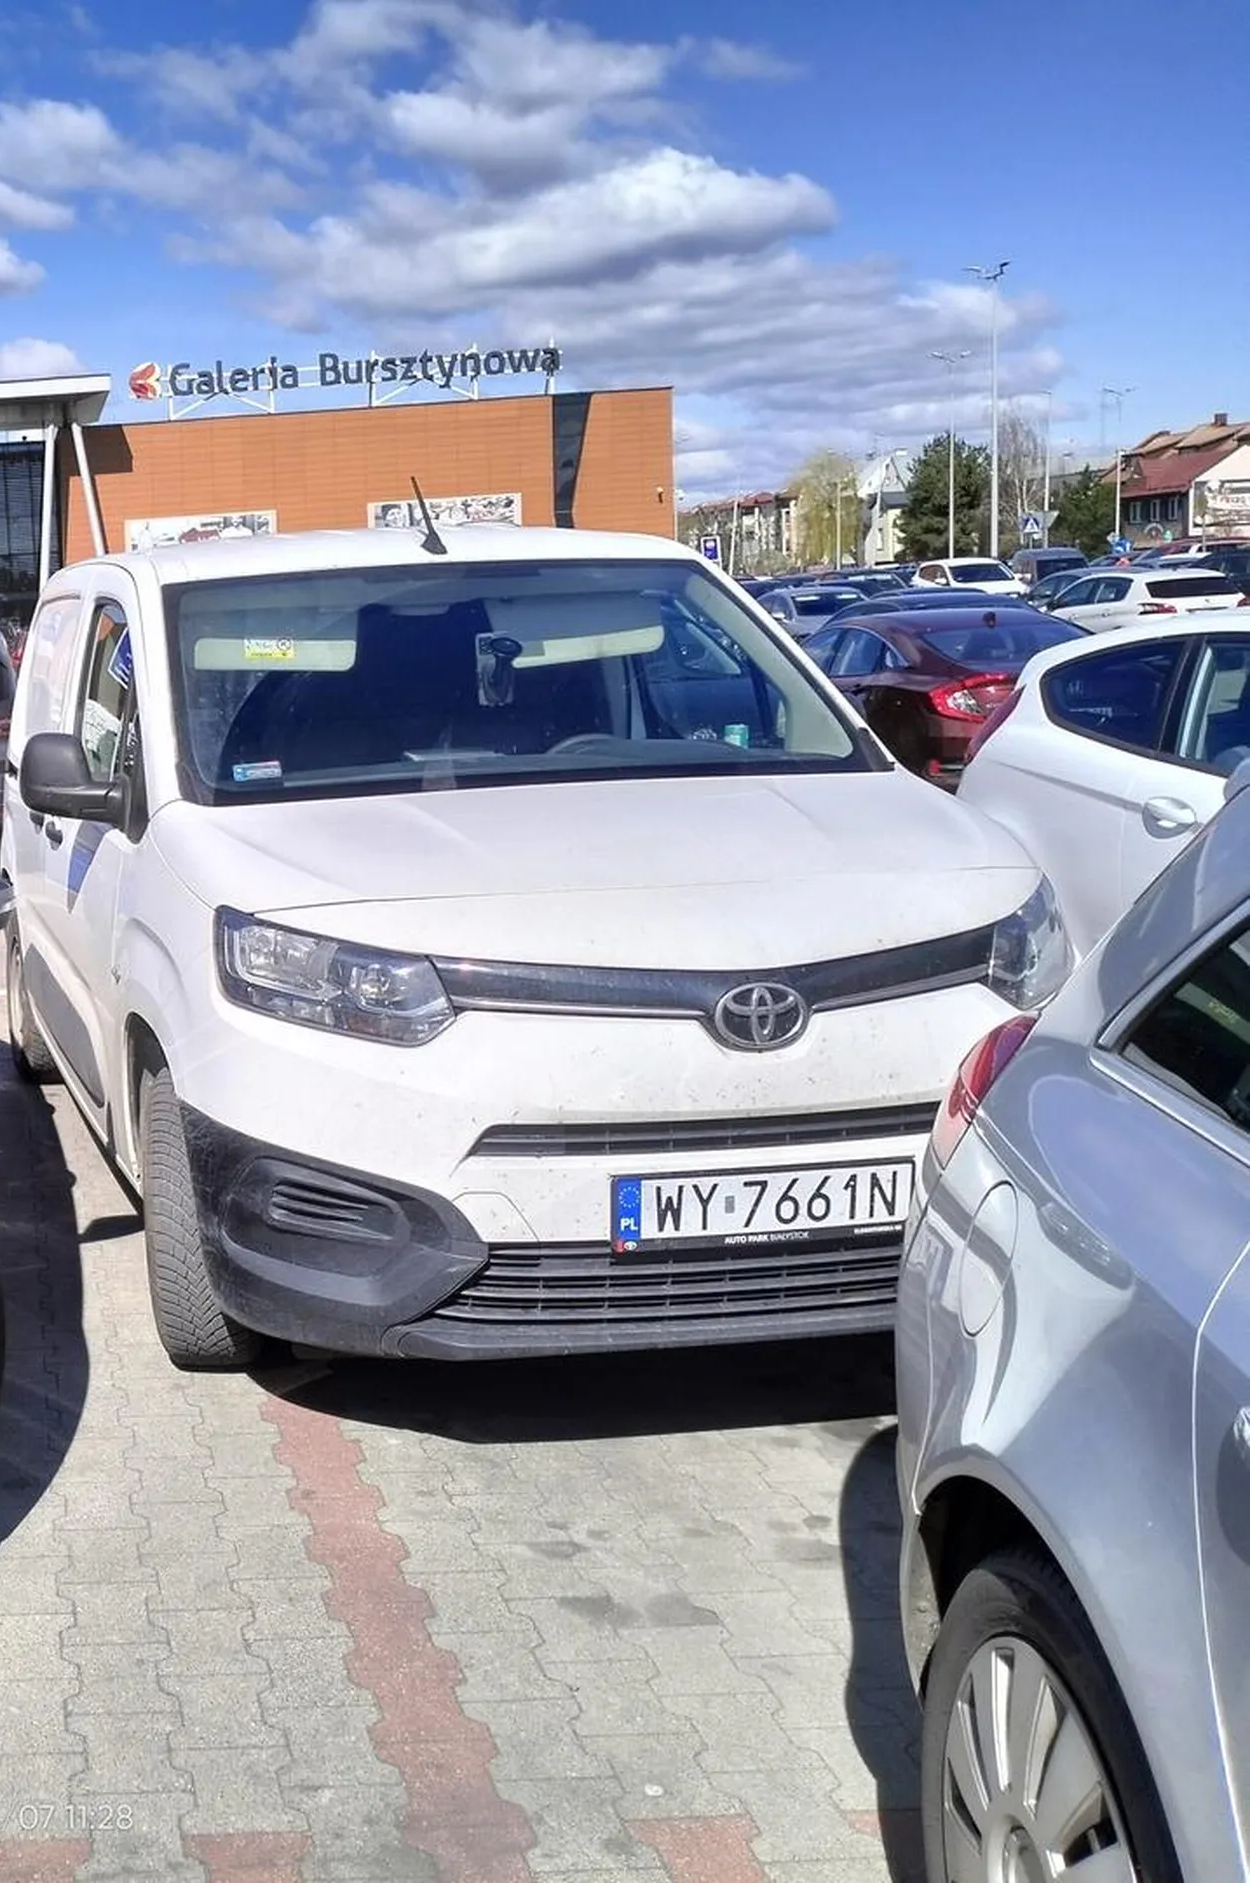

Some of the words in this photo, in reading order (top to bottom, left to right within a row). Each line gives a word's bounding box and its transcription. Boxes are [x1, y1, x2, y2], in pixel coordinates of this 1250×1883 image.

[169, 356, 299, 397] Galeria
[318, 346, 562, 389] Bursztynowa
[619, 1217, 638, 1232] PL
[655, 1182, 719, 1233] WY
[742, 1170, 898, 1228] 7661N
[724, 1234, 747, 1244] AUTO
[748, 1233, 769, 1242] PARK
